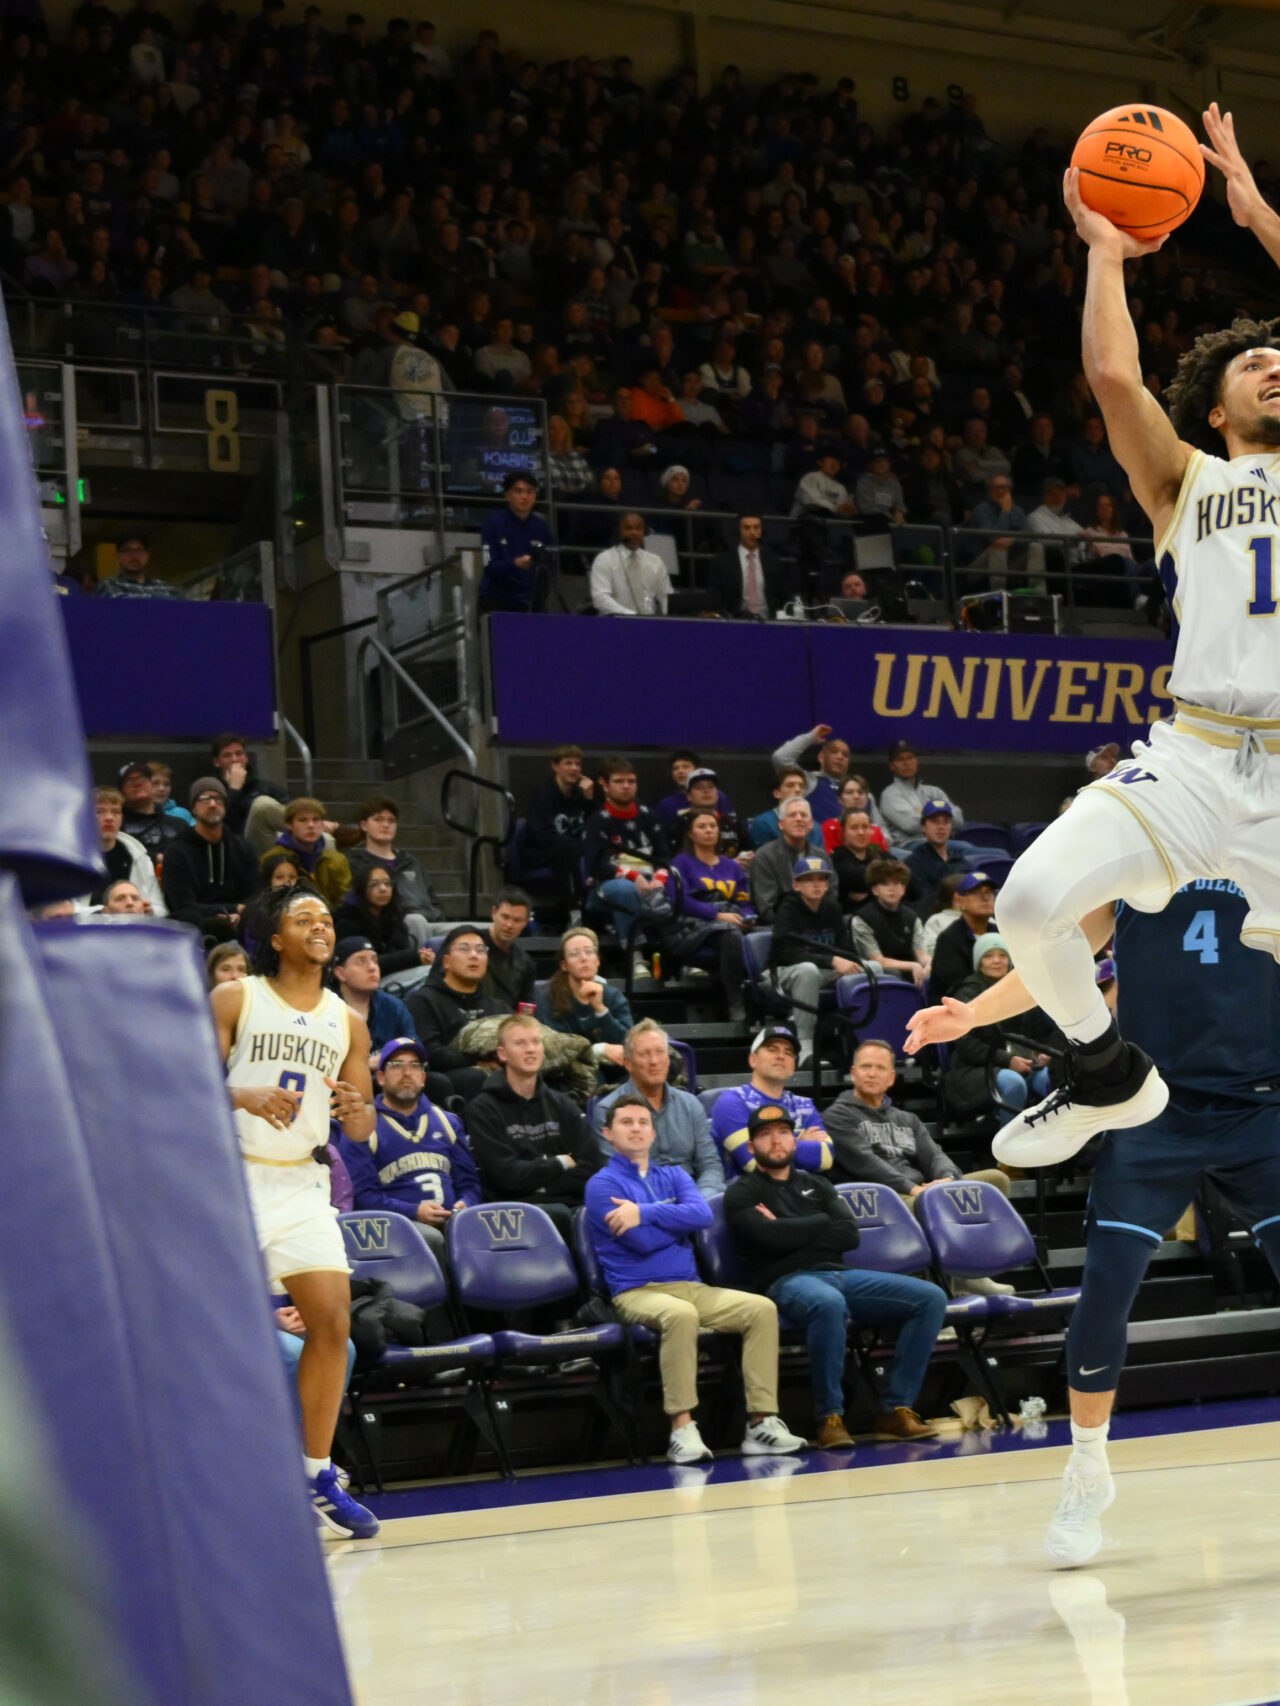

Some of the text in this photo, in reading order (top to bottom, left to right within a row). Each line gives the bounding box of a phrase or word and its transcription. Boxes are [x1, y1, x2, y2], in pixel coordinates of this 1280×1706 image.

[1105, 142, 1152, 163] PRO
[205, 389, 240, 473] 8
[872, 652, 1176, 726] UNIVERS
[1182, 909, 1219, 965] 4
[249, 1032, 339, 1077] HUSKIES
[413, 1172, 445, 1206] 3
[838, 1188, 879, 1219] W
[943, 1185, 984, 1215] W
[343, 1217, 391, 1250] W
[477, 1209, 525, 1241] W
[363, 1412, 376, 1423] 13
[496, 1401, 508, 1410] 14
